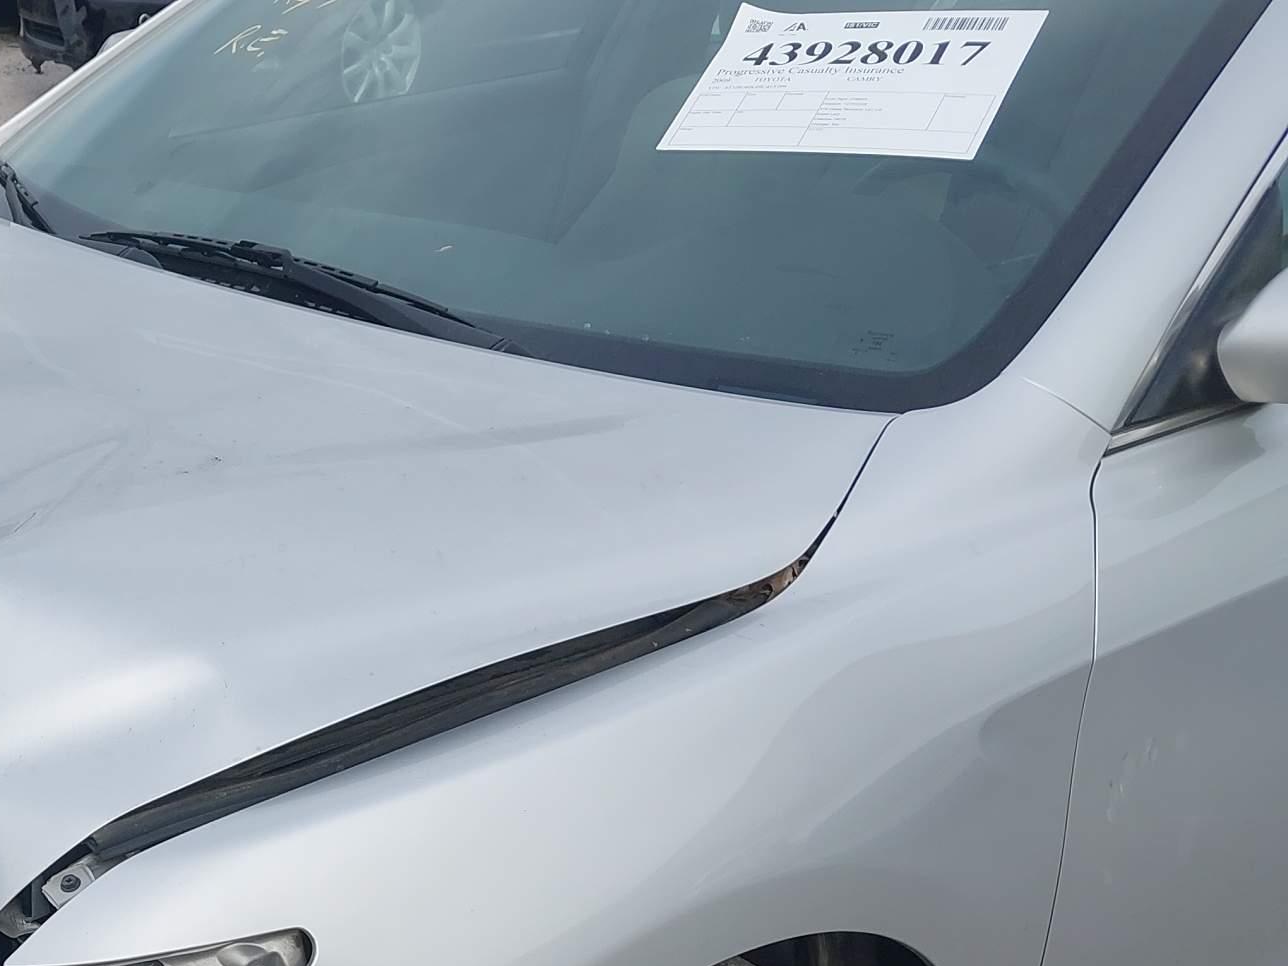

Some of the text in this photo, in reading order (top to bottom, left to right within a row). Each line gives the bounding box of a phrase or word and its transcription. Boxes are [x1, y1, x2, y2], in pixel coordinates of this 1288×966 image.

[742, 40, 992, 66] 43928017
[716, 66, 905, 77] Progressive Casualty Insurance
